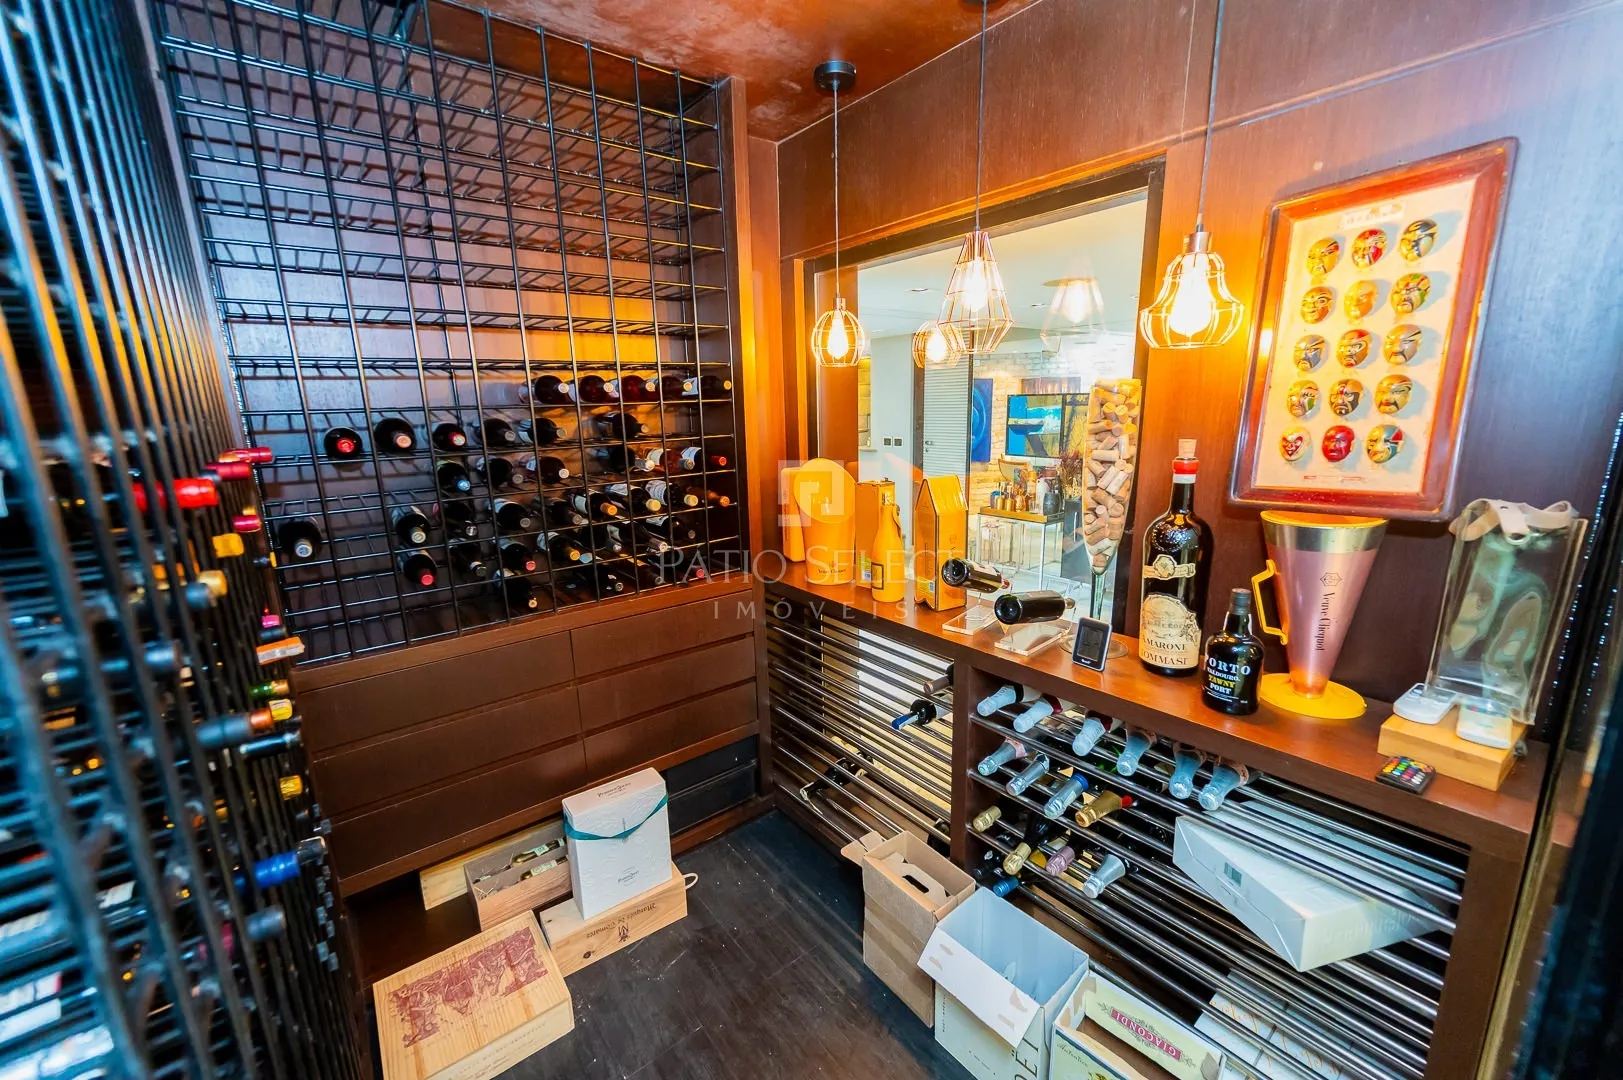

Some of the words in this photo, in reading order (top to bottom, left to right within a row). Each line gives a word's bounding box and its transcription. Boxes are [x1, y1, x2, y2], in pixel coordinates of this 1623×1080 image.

[1320, 592, 1335, 616] Veuve
[1314, 618, 1331, 651] Clicquot
[1208, 675, 1236, 689] TAWNY
[1209, 682, 1232, 695] PORT
[1116, 1011, 1177, 1057] GIACONDI
